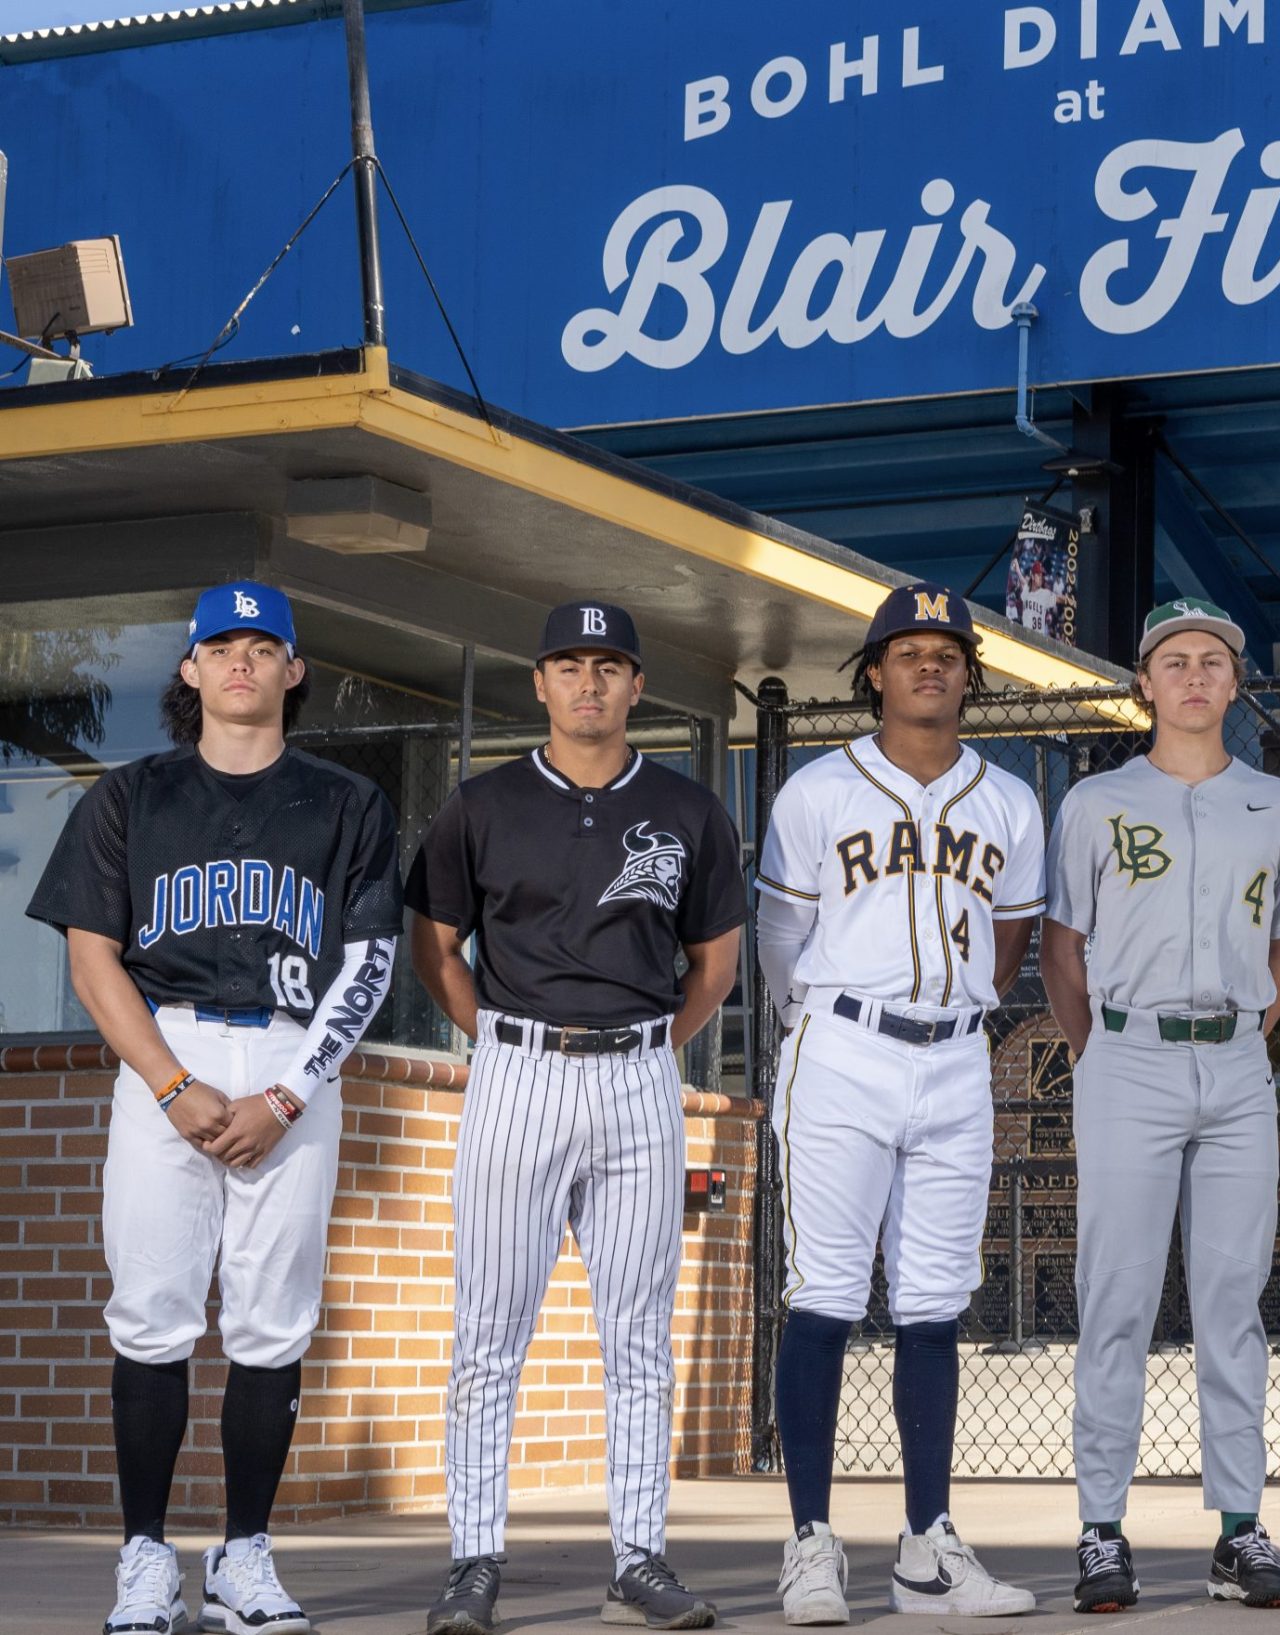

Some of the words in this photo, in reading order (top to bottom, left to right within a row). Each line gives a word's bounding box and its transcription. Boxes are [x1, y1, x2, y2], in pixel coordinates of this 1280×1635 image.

[682, 26, 946, 144] BOHL
[1053, 79, 1106, 125] at
[560, 178, 1047, 373] Blair
[233, 590, 260, 619] LB
[914, 592, 951, 623] M
[836, 820, 1005, 906] RAMS
[138, 859, 325, 961] JORDAN
[1241, 866, 1271, 929] 4
[950, 907, 970, 963] 4
[267, 952, 315, 1011] 18
[303, 1032, 343, 1079] THE
[326, 936, 395, 1043] NORT
